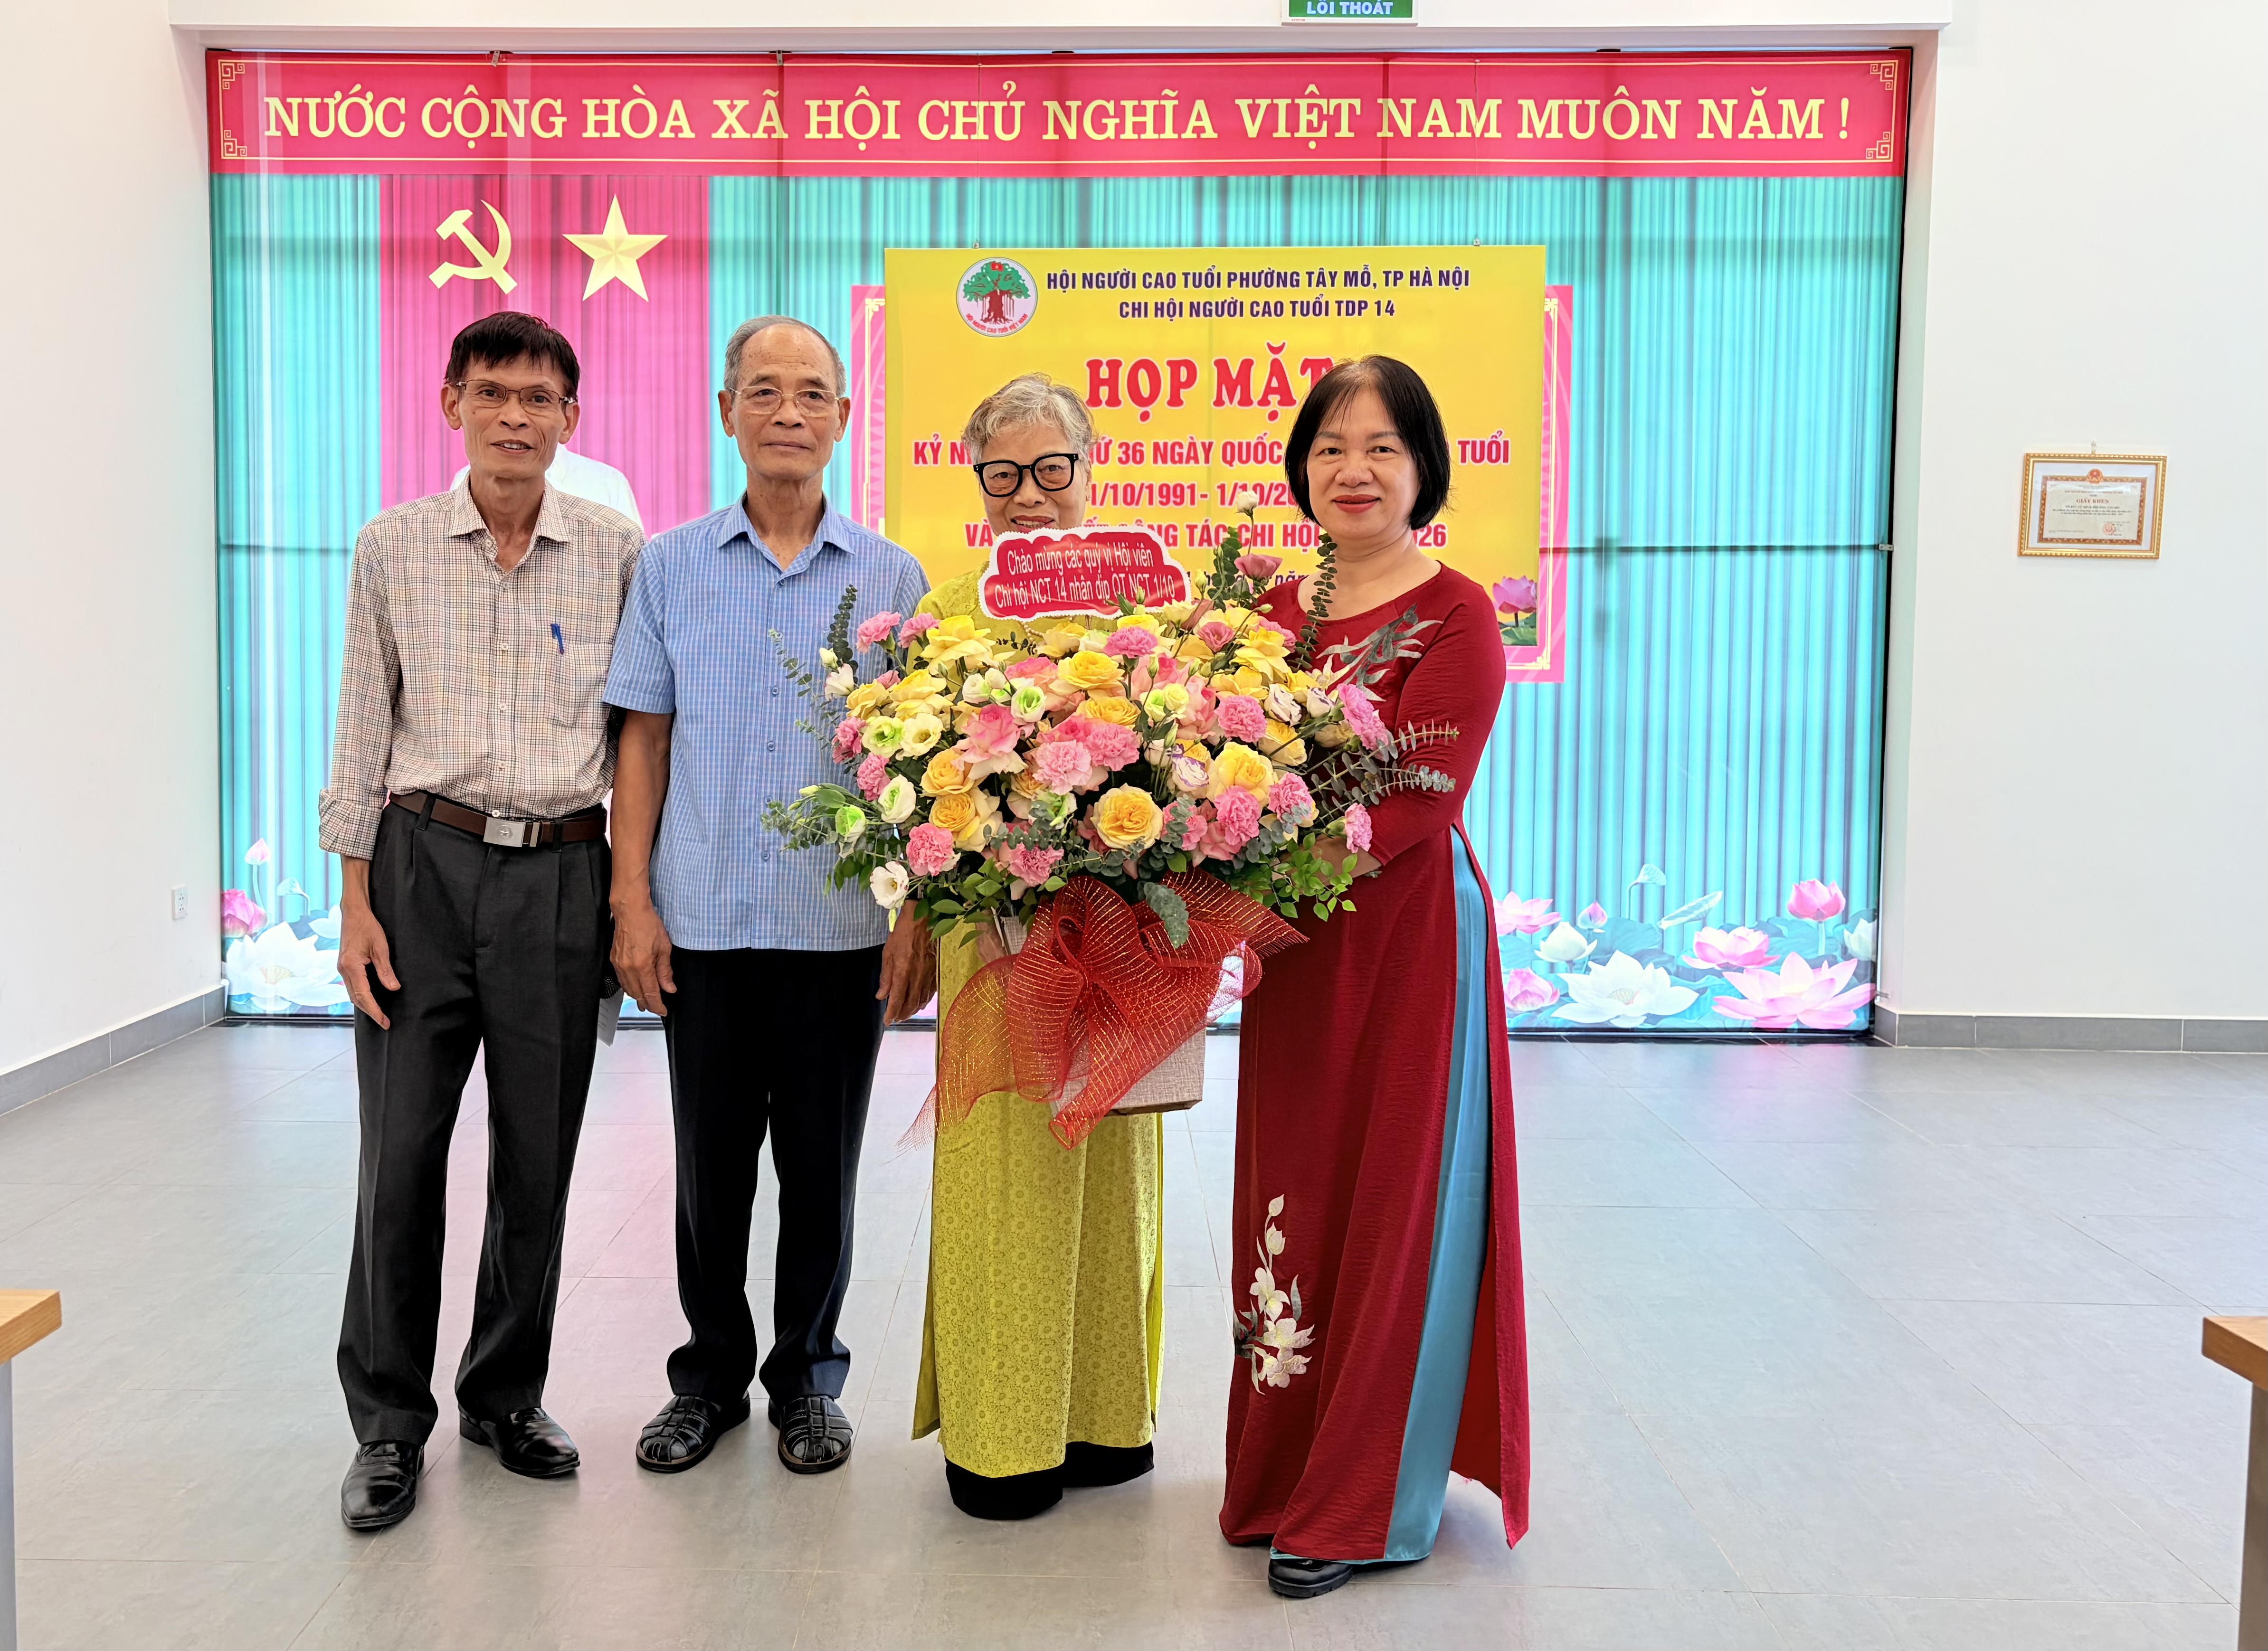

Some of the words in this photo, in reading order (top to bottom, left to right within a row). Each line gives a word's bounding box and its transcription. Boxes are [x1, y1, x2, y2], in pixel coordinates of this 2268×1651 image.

[265, 84, 406, 139] NƯỚC
[421, 85, 567, 149] CỘNG
[582, 84, 696, 139] HÒA
[711, 89, 788, 139] XÃ
[805, 85, 901, 151] HỘI
[918, 80, 1025, 141] CHỦ
[1042, 88, 1218, 141] NGHĨA
[1234, 84, 1361, 150] VIỆT
[1376, 98, 1502, 140] NAM
[1517, 85, 1682, 140] MUÔN
[1697, 86, 1825, 139] NĂM
[1047, 269, 1076, 293] HỘI
[1082, 268, 1136, 289] NGƯỜI
[1142, 272, 1176, 289] CAO
[1182, 264, 1221, 289] TUỔI
[1227, 267, 1300, 288] PHƯỜNG
[1305, 267, 1338, 288] TÂY
[1344, 264, 1377, 290] MỖ,
[1383, 270, 1404, 287] TP
[1410, 266, 1433, 287] HÀ
[1438, 266, 1470, 290] NỘI
[1119, 301, 1148, 318] CHI
[1154, 297, 1184, 321] HỘI
[1189, 296, 1243, 318] NGƯỜI
[1250, 300, 1284, 317] CAO
[1290, 293, 1329, 317] TUỔI
[1335, 300, 1368, 316] TDP
[1374, 300, 1395, 316] 14
[1086, 359, 1197, 422] HỌP
[914, 433, 942, 465] KỶ
[1117, 442, 1144, 465] 36
[1153, 436, 1214, 465] NGÀY
[1222, 432, 1283, 468] QUỐC
[1457, 430, 1509, 463] TUỔI
[965, 519, 994, 547] VÀ
[1238, 524, 1274, 547] CHI
[1007, 548, 1033, 575] Chào
[1034, 545, 1064, 576] mừng
[1065, 543, 1082, 569] các
[1084, 542, 1101, 574] quý
[1102, 542, 1114, 572] vị
[1113, 542, 1132, 571] Hội
[1132, 542, 1154, 567] viên
[995, 582, 1013, 608] Chi
[1012, 580, 1030, 610] hội
[1029, 577, 1052, 604] NCT
[1054, 575, 1067, 602] 14
[1069, 574, 1094, 601] nhân
[1095, 573, 1110, 606] dịp
[1153, 573, 1176, 599] 1/10
